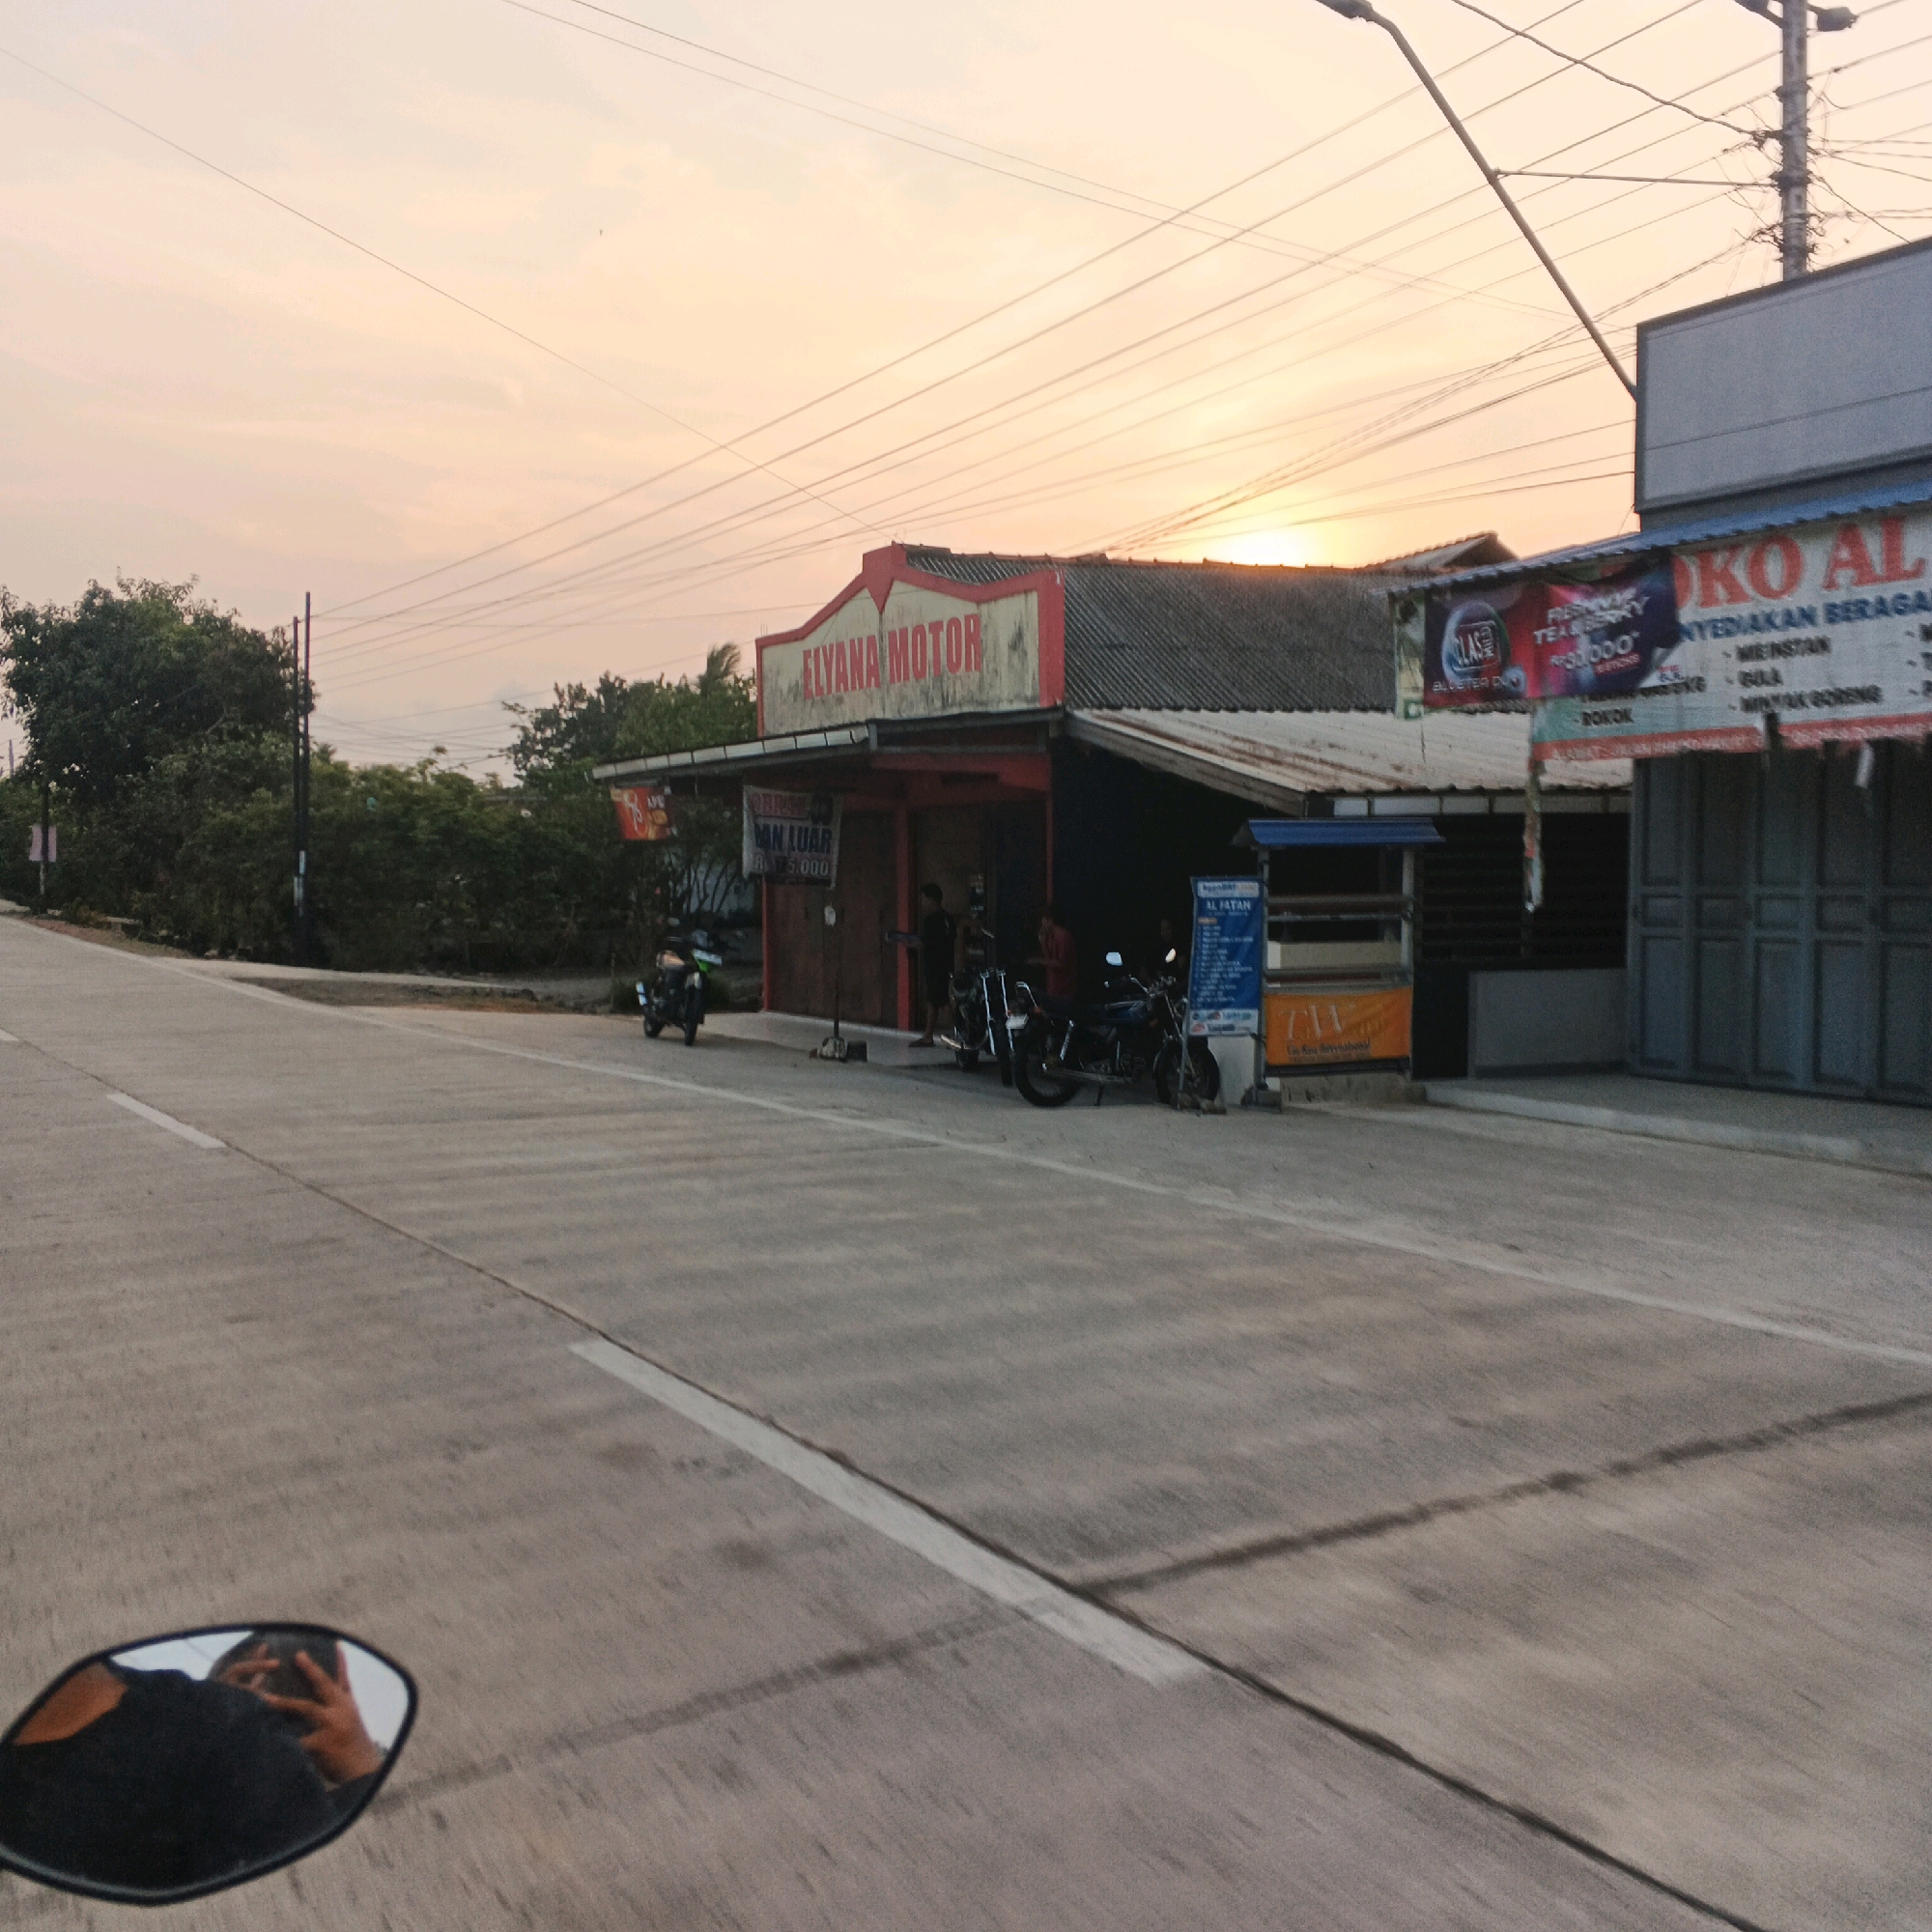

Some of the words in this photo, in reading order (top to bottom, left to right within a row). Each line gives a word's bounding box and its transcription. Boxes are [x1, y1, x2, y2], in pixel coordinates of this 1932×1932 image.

[1822, 515, 1926, 592] AL
[803, 635, 881, 700] ELYANA
[888, 613, 982, 684] MOTOR
[1582, 709, 1634, 726] ROKOK
[754, 823, 783, 851] BAN
[788, 826, 833, 854] LUAR
